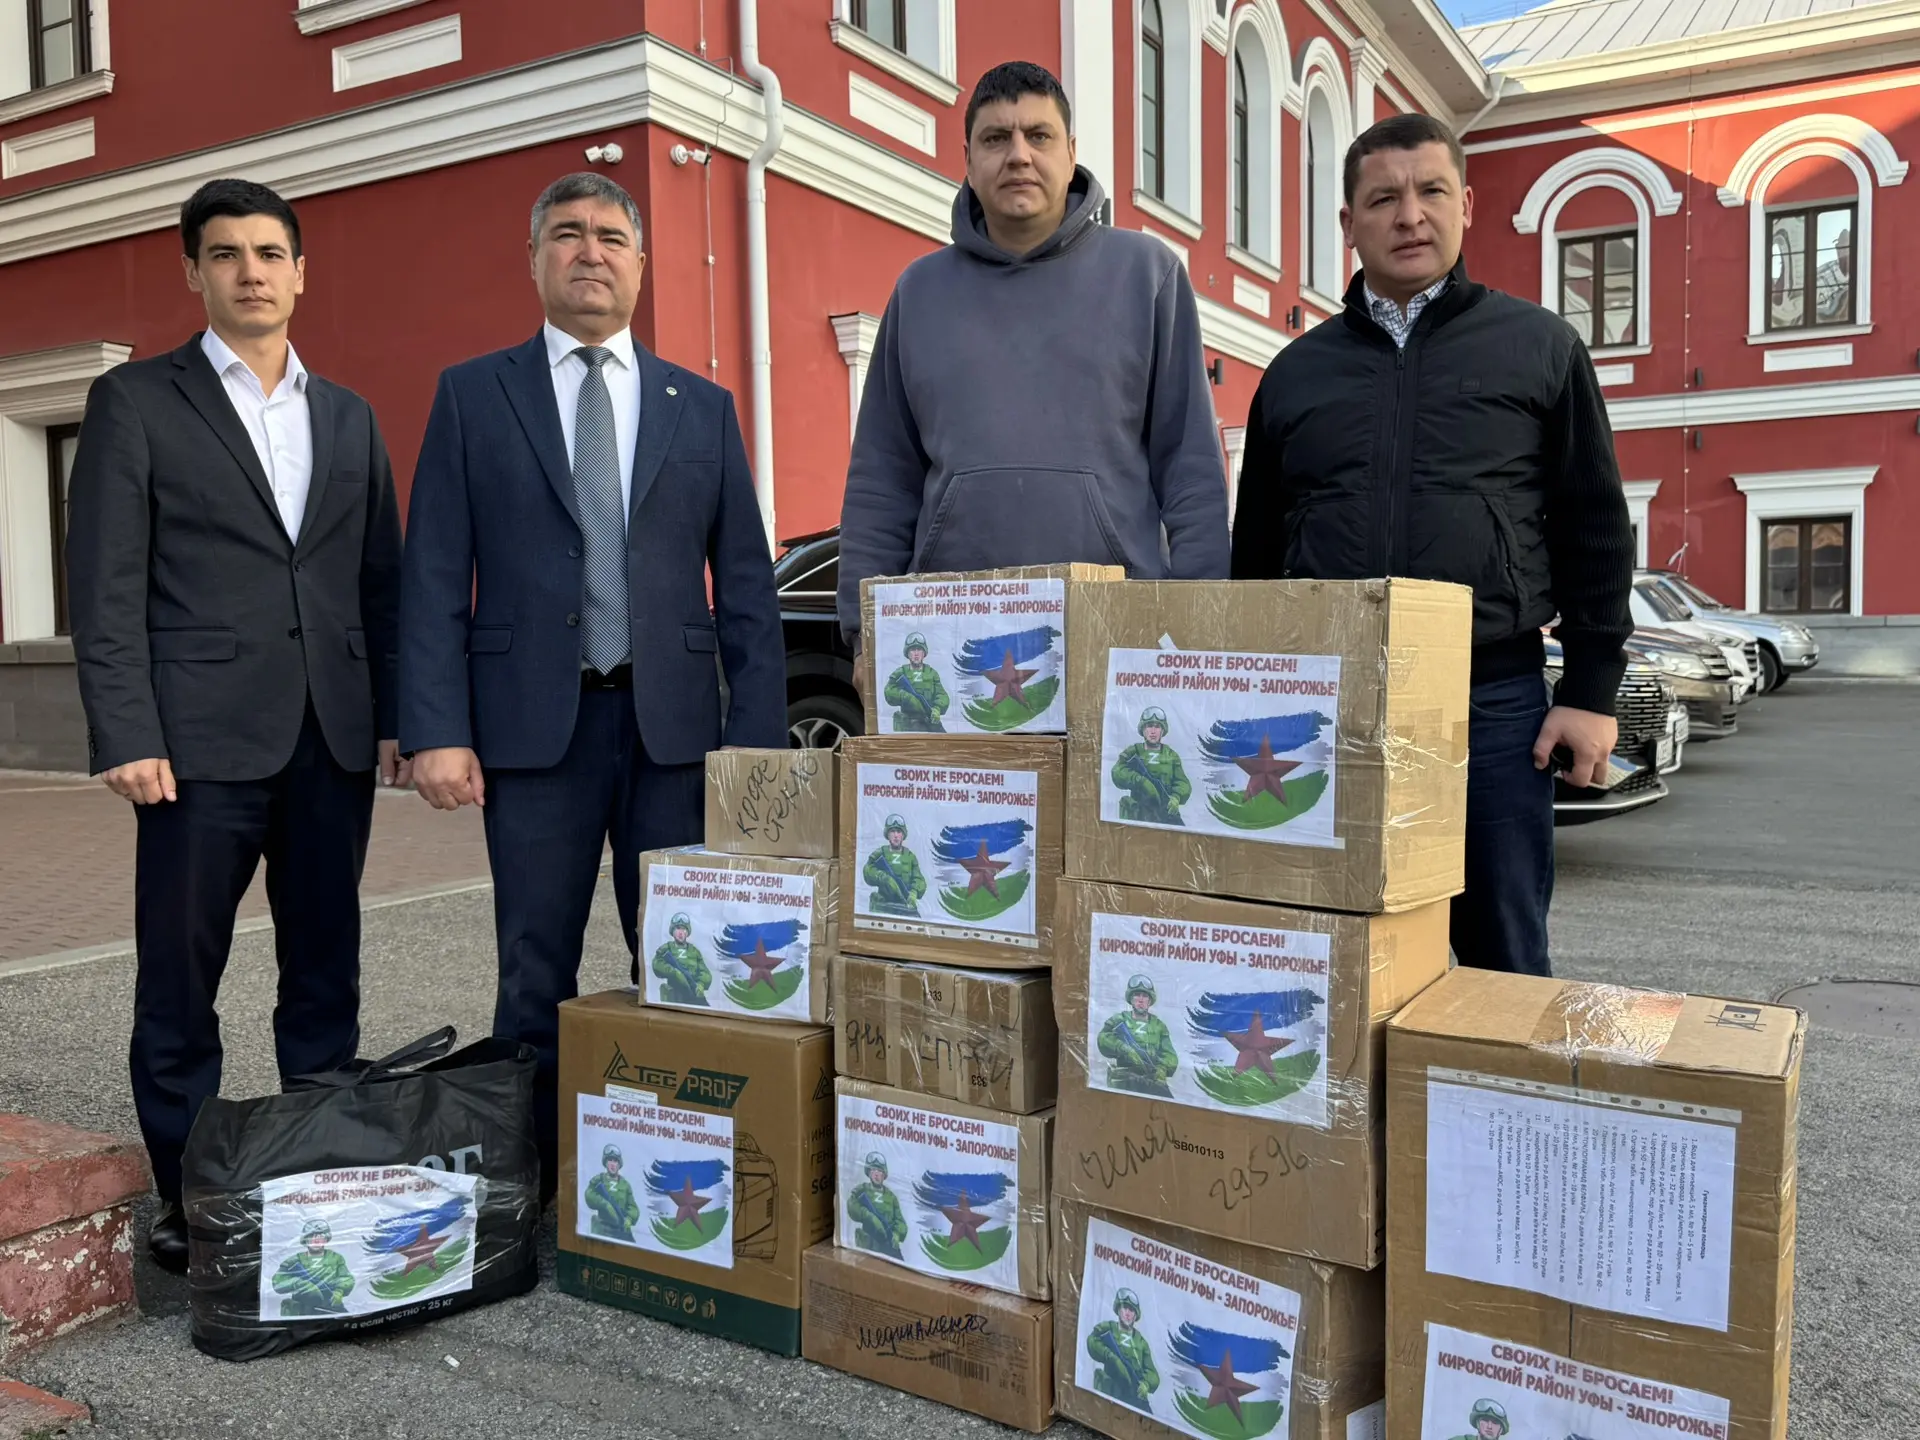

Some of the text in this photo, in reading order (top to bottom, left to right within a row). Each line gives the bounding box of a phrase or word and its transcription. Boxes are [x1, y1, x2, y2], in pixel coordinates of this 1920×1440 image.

[914, 583, 1029, 598] СВОИХ НЕ БРОСАЕМ!
[881, 600, 934, 617] КИРОВСКИЙ
[935, 599, 966, 615] РАЙОН
[969, 603, 991, 615] УФЫ
[1156, 654, 1297, 672] СВОИХ НЕ БРОСАЕМ!
[1116, 671, 1180, 689] КИРОВСКИЙ
[1182, 672, 1220, 691] РАЙОН
[1223, 679, 1249, 693] УФЫ
[894, 769, 1004, 786] СВОИХ НЕ БРОСАЕМ!
[863, 783, 914, 799] КИРОВСКИЙ
[916, 784, 946, 801] РАЙОН
[948, 789, 969, 803] УФЫ
[683, 870, 783, 888] СВОИХ НЕ БРОСАЕМ!
[653, 884, 701, 899] КИРОВСКИЙ
[702, 886, 730, 901] РАЙОН
[732, 891, 750, 903] УФЫ
[1140, 922, 1285, 948] СВОИХ НЕ БРОСАЕМ!
[1100, 938, 1165, 958] КИРОВСКИЙ
[1168, 942, 1206, 962] РАЙОН
[1209, 949, 1237, 966] УФЫ
[686, 1074, 741, 1100] PROF
[583, 1113, 628, 1130] КИРОВСКИЙ
[629, 1119, 655, 1135] РАЙОН
[657, 1126, 675, 1140] УФЫ
[610, 1102, 705, 1127] СВОИХ НЕ БРОСАЕМ!
[875, 1105, 985, 1136] СВОИХ НЕ БРОСАЕМ!
[844, 1117, 895, 1137] КИРОВСКИЙ
[896, 1126, 926, 1143] РАЙОН
[928, 1133, 948, 1149] УФЫ
[1173, 1139, 1225, 1160] SB010113
[314, 1170, 358, 1185] СВОИХ
[362, 1170, 379, 1181] НЕ
[1209, 1126, 1308, 1210] 29596
[380, 1184, 405, 1197] УФЫ
[1700, 1189, 1709, 1233] Гуманитарная
[1093, 1243, 1153, 1276] КИРОВСКИЙ
[1154, 1263, 1189, 1291] РАЙОН
[1191, 1278, 1216, 1302] УФЫ
[1130, 1237, 1260, 1296] СВОИХ НЕ БРОСАЕМ!
[385, 1306, 420, 1325] честно
[427, 1300, 441, 1310] 25
[1438, 1351, 1523, 1386] КИРОВСКИЙ
[1526, 1371, 1574, 1401] РАЙОН
[1578, 1389, 1613, 1412] УФЫ
[1491, 1344, 1674, 1405] СВОИХ НЕ БРОСАЕМ!
